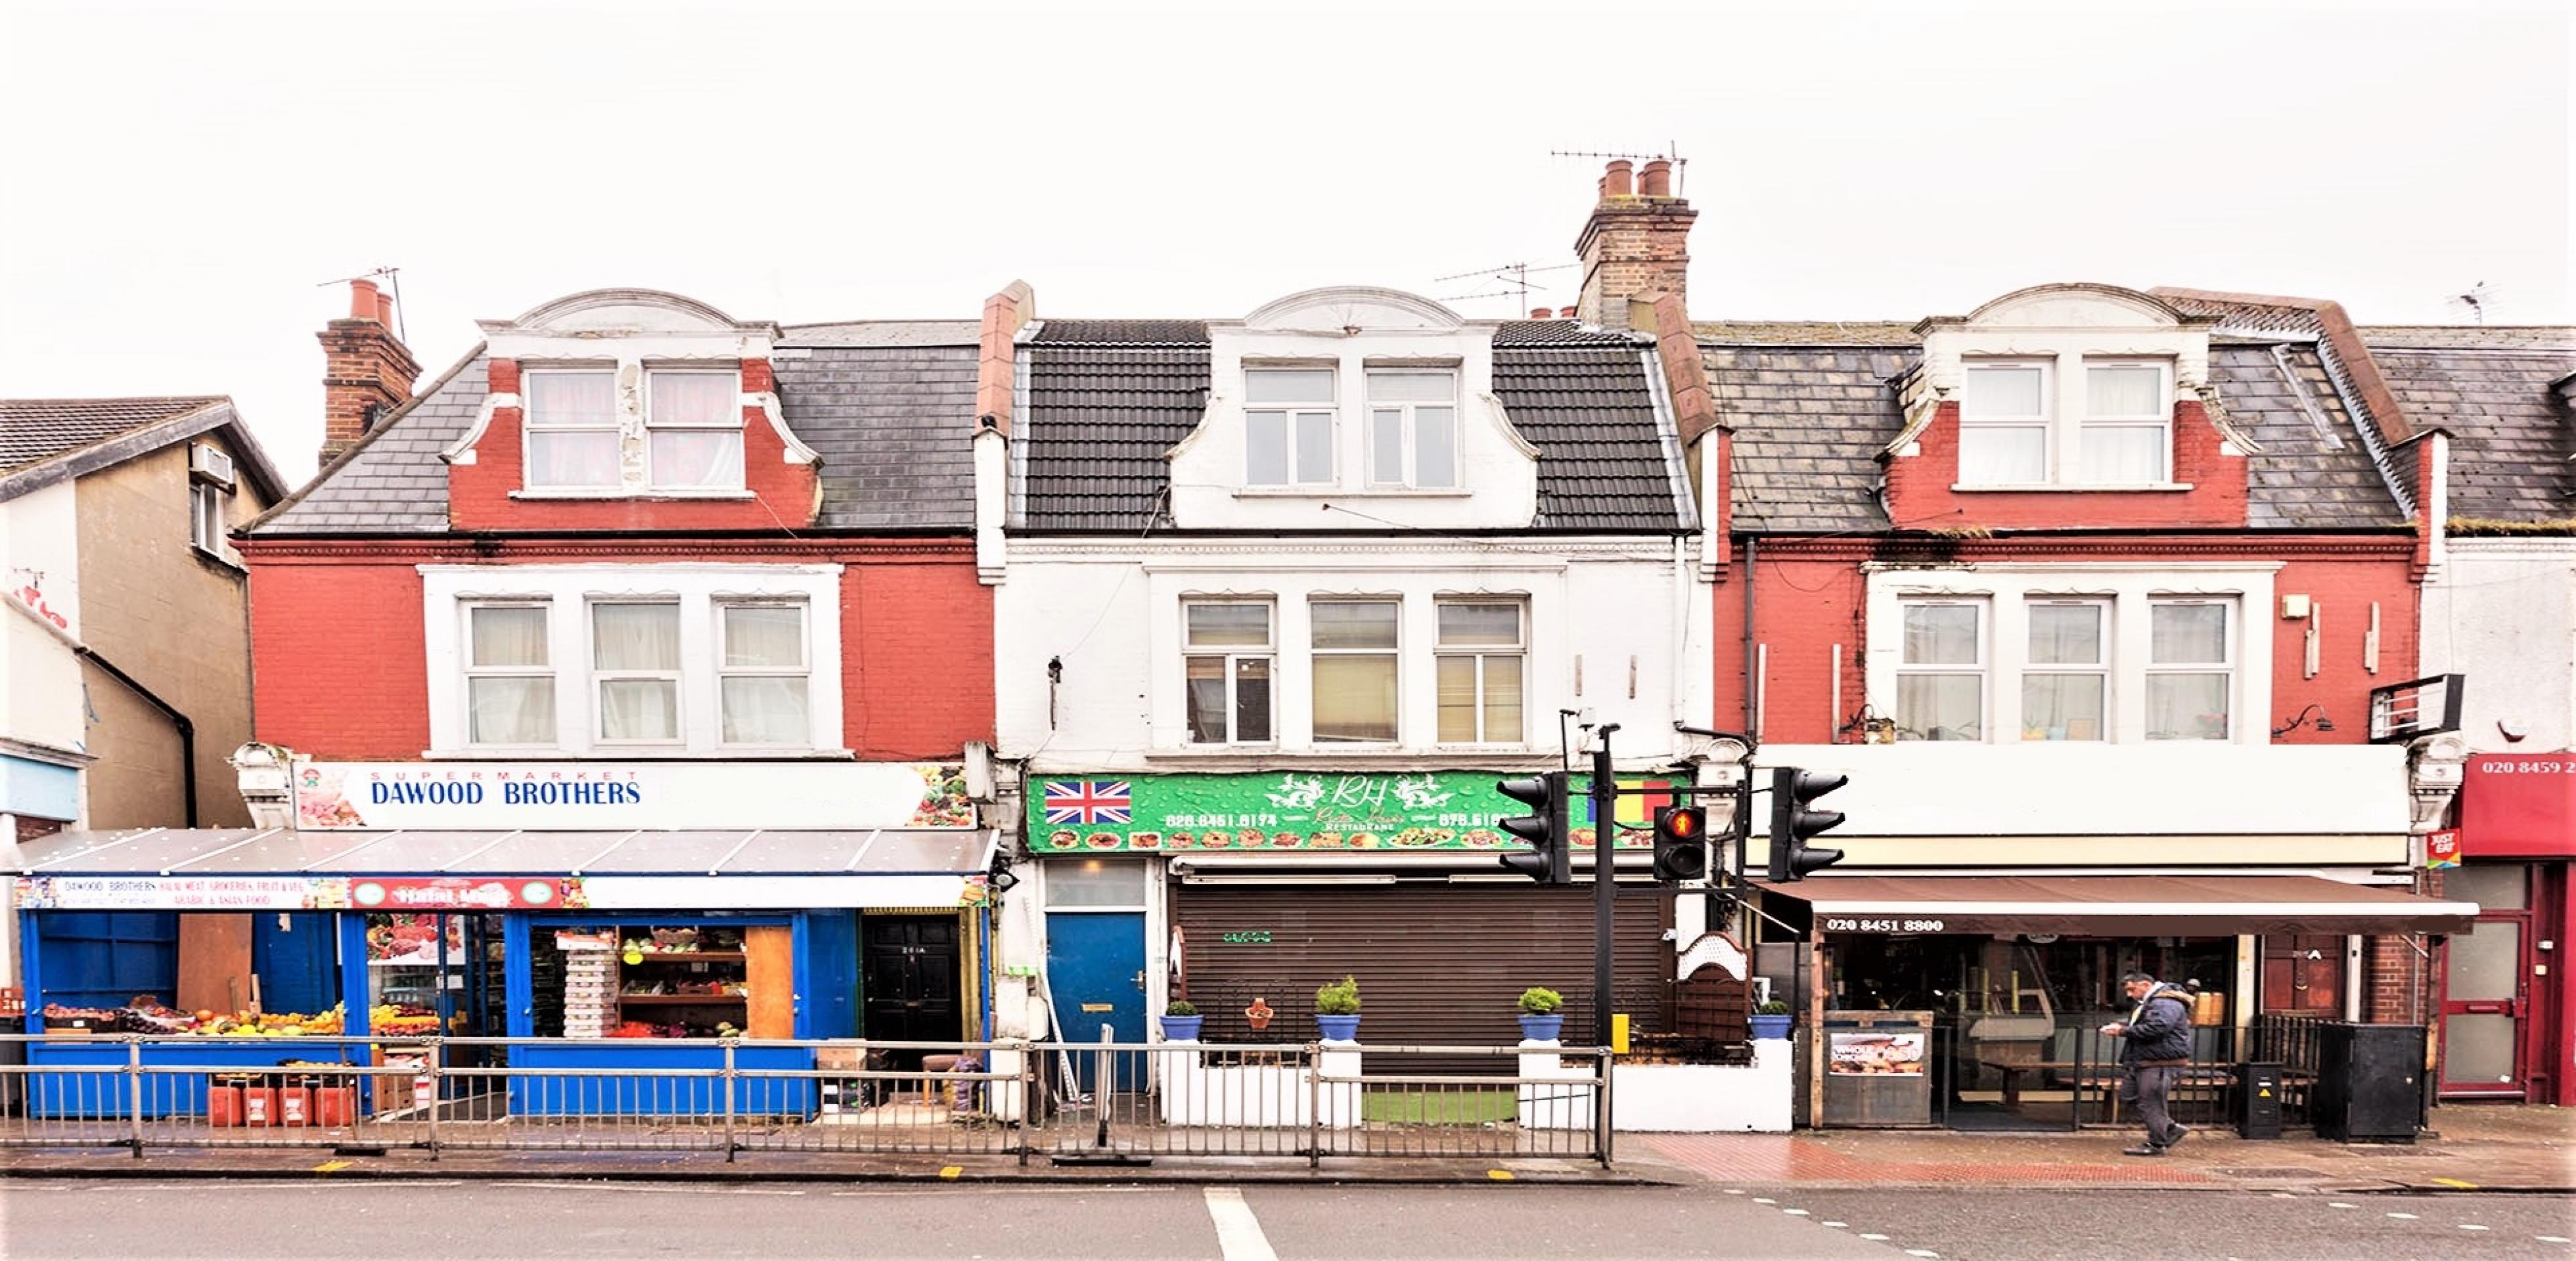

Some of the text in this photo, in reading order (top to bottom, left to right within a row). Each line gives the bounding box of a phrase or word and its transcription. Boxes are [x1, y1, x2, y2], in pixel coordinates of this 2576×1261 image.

[2482, 761, 2514, 773] 020
[2518, 761, 2561, 774] 8459
[371, 772, 636, 780] SUPERMARKET
[372, 782, 641, 805] DAWOOD BROTHERS
[2431, 833, 2456, 845] JUST
[2435, 843, 2455, 854] EAT
[1827, 919, 1944, 932] 020 8451 8800
